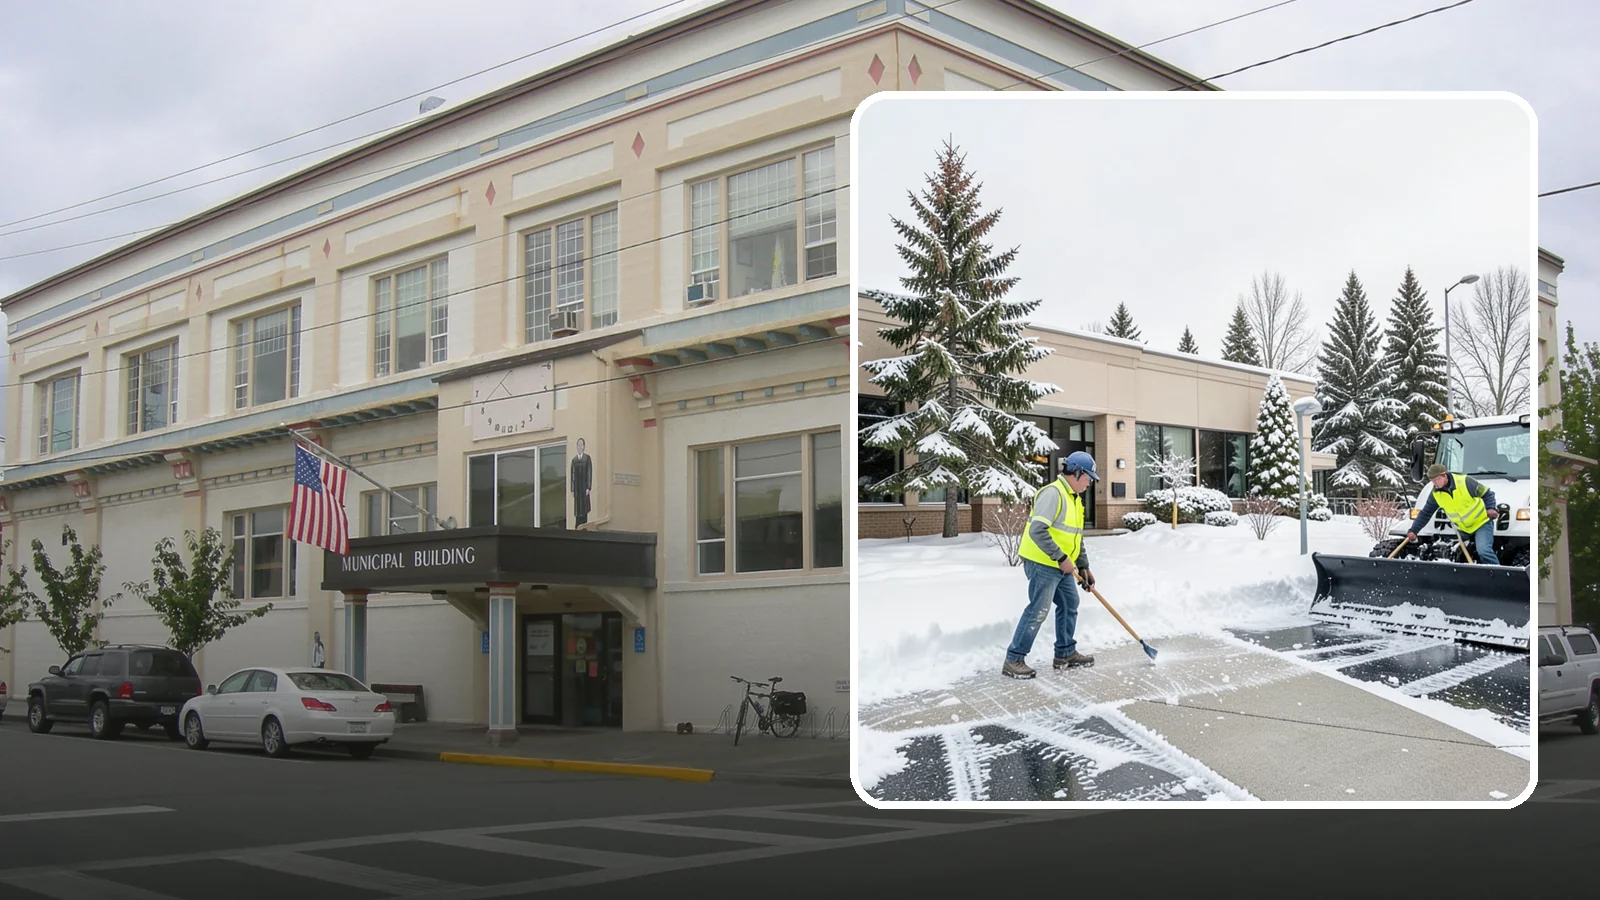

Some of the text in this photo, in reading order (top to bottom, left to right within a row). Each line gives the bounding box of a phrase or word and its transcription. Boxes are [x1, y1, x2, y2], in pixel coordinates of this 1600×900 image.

[536, 402, 540, 410] 4
[480, 407, 485, 415] 8
[488, 417, 492, 426] 9
[529, 414, 533, 422] 3
[494, 424, 500, 432] 10
[521, 420, 525, 428] 2
[501, 426, 506, 434] 11
[507, 425, 513, 433] 12
[342, 546, 475, 572] MUNICIPAL BUILDING
